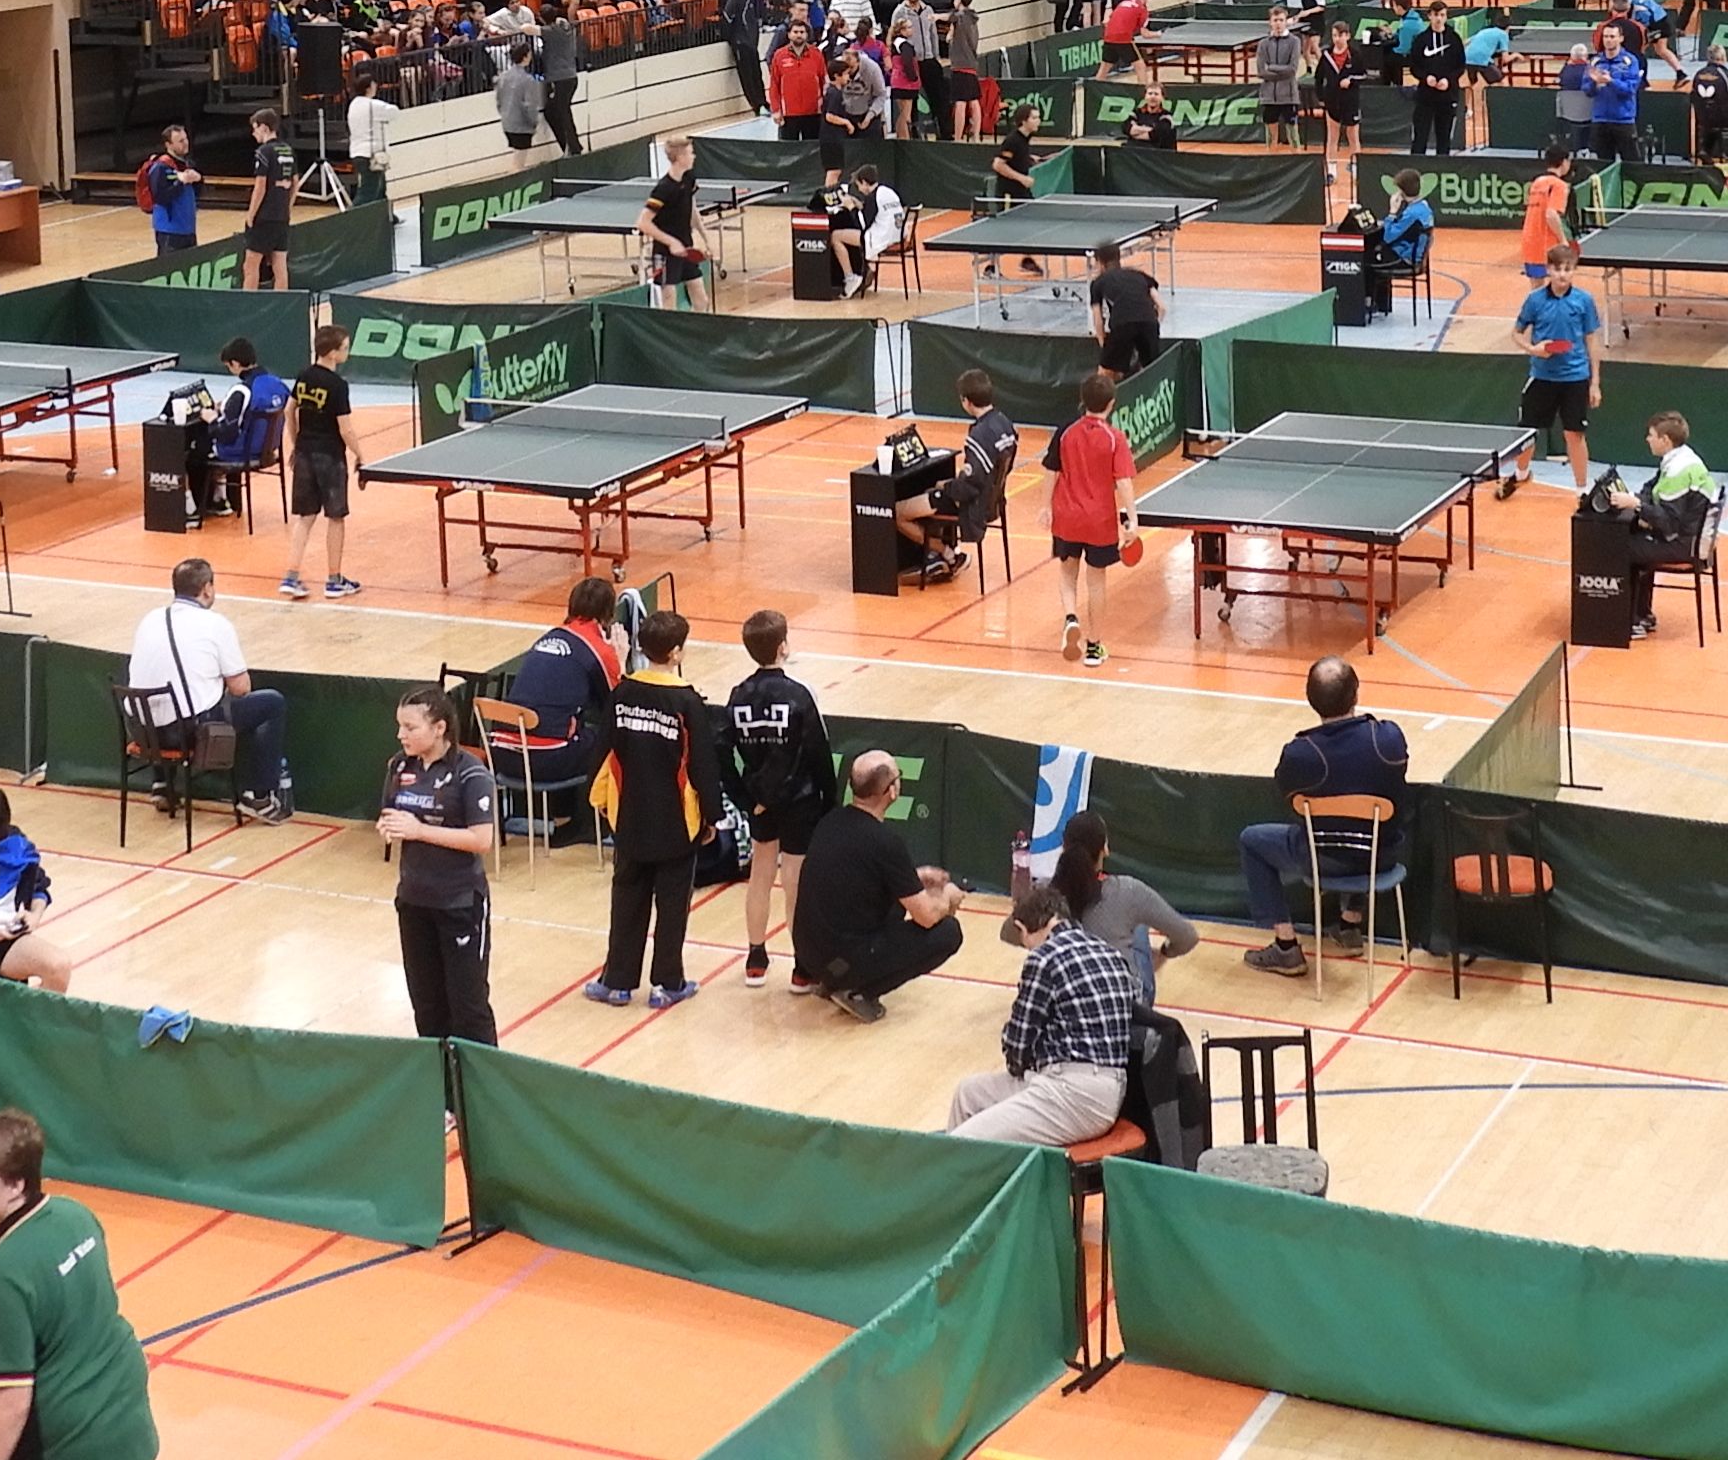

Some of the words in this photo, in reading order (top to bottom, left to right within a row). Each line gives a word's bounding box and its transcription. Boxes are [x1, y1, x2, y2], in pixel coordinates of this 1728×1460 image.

[1097, 96, 1260, 126] DNIC
[855, 504, 893, 519] TIBHAR
[1578, 575, 1620, 591] JOOLA
